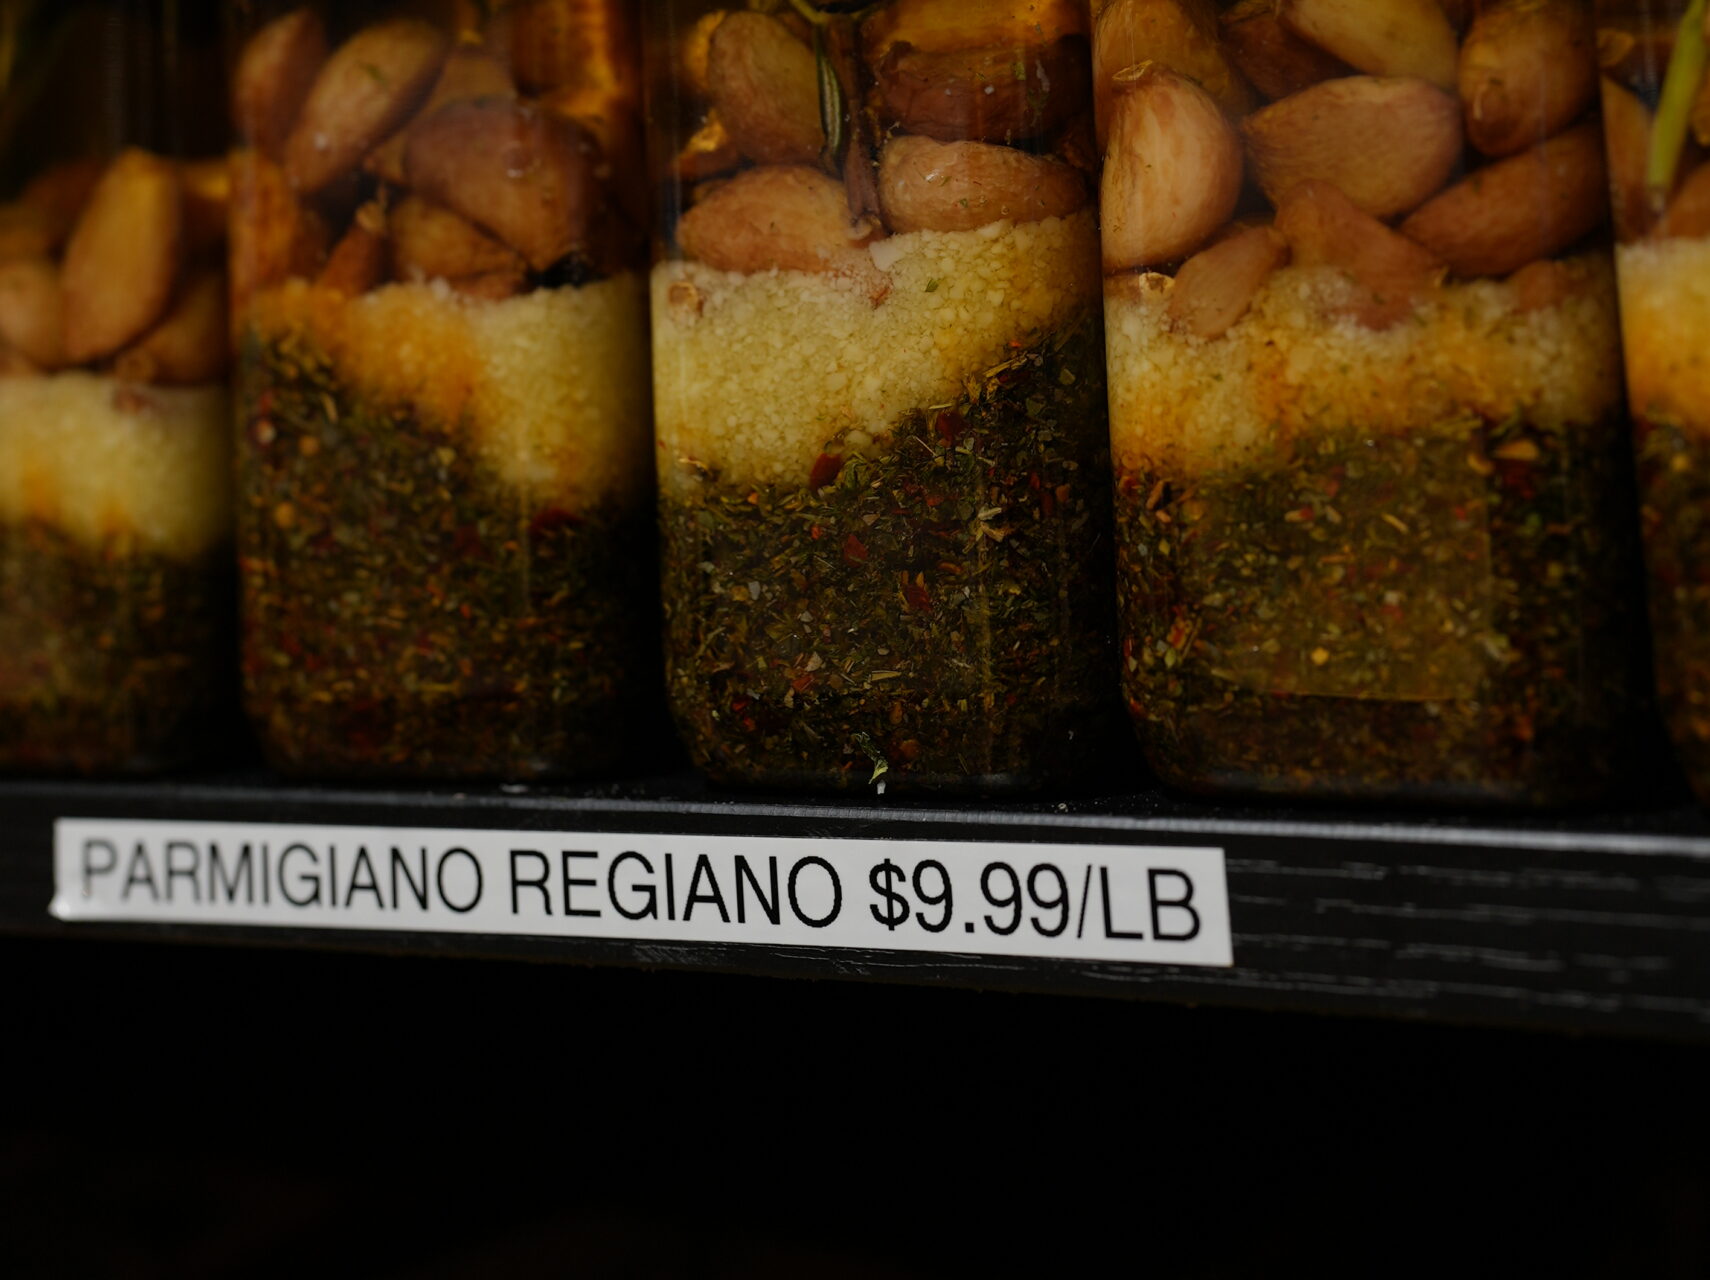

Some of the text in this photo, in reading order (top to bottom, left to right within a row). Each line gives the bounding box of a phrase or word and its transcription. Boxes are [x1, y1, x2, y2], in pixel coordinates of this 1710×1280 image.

[81, 838, 1202, 942] PARMIGIANO REGIANO $9.99/LB
